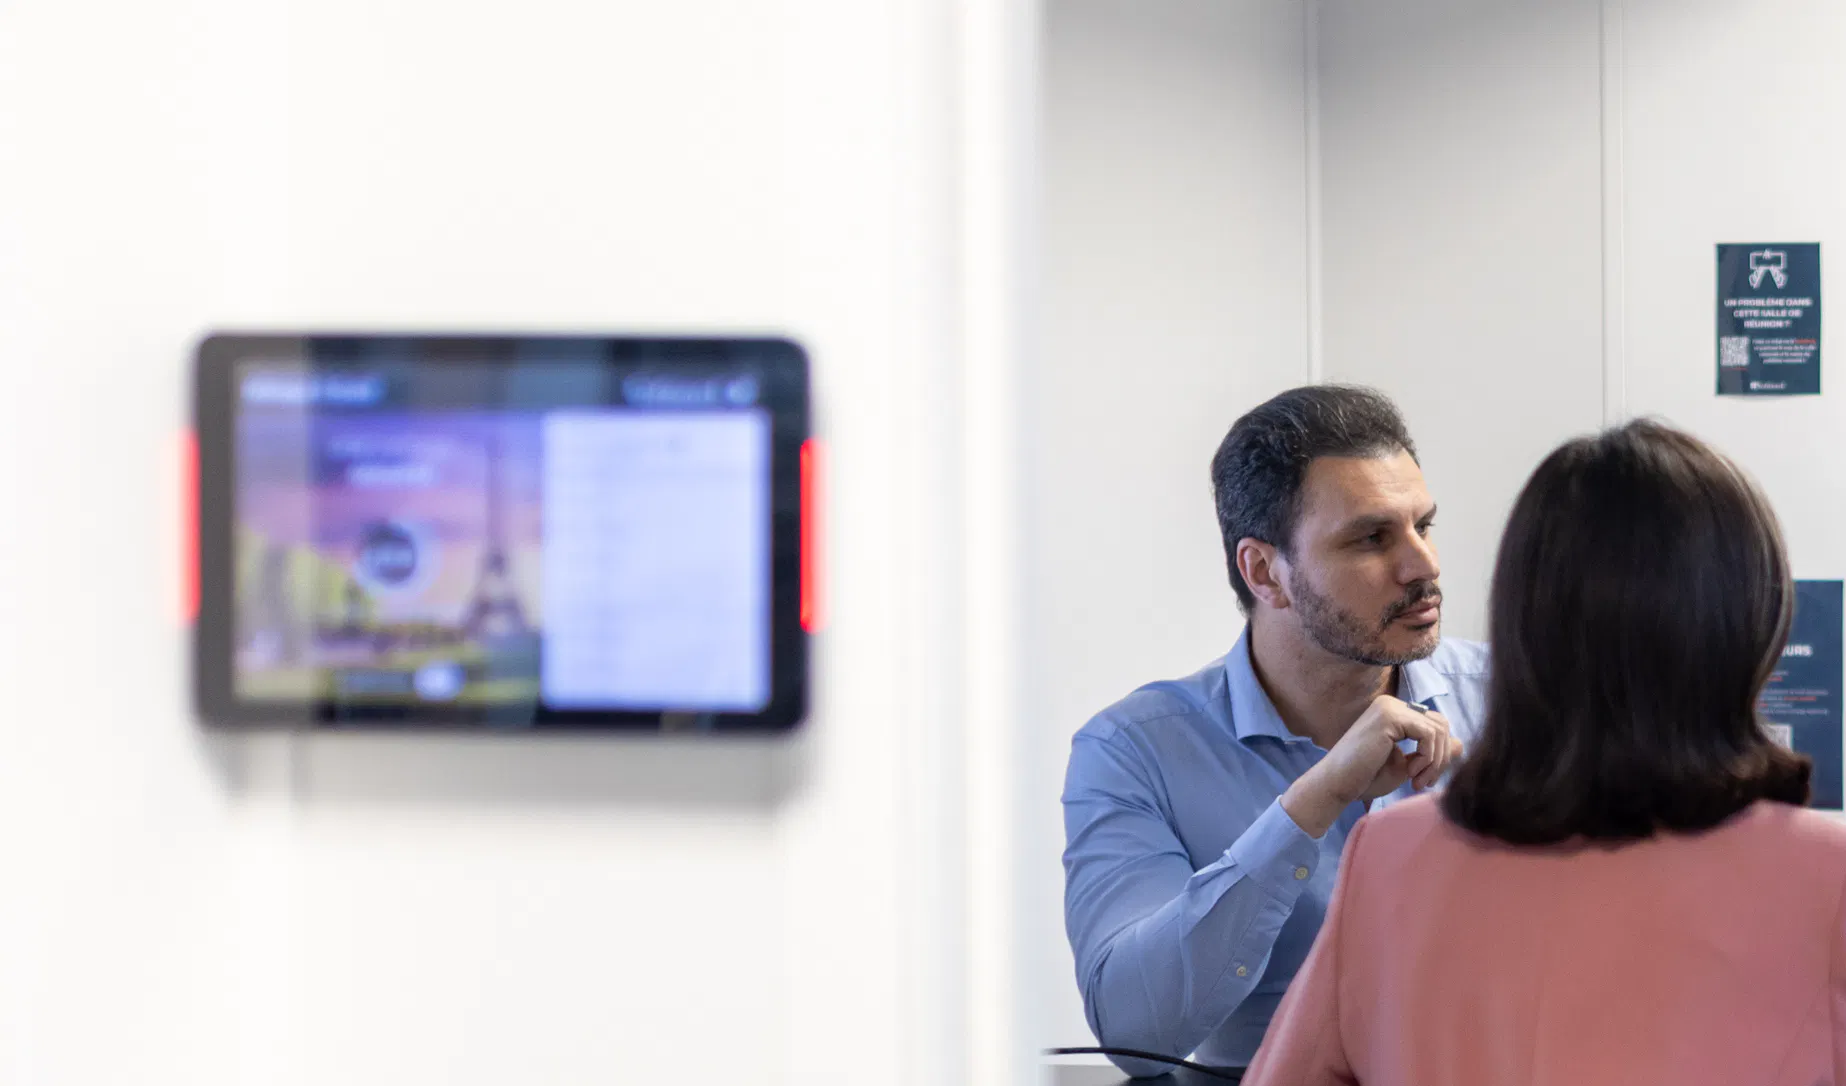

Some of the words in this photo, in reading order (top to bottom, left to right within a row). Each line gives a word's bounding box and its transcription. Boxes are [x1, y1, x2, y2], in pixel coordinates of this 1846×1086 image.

[1786, 298, 1811, 306] DANS
[1733, 309, 1760, 318] CETTE
[1761, 309, 1787, 318] SALLE
[1788, 309, 1802, 318] DE
